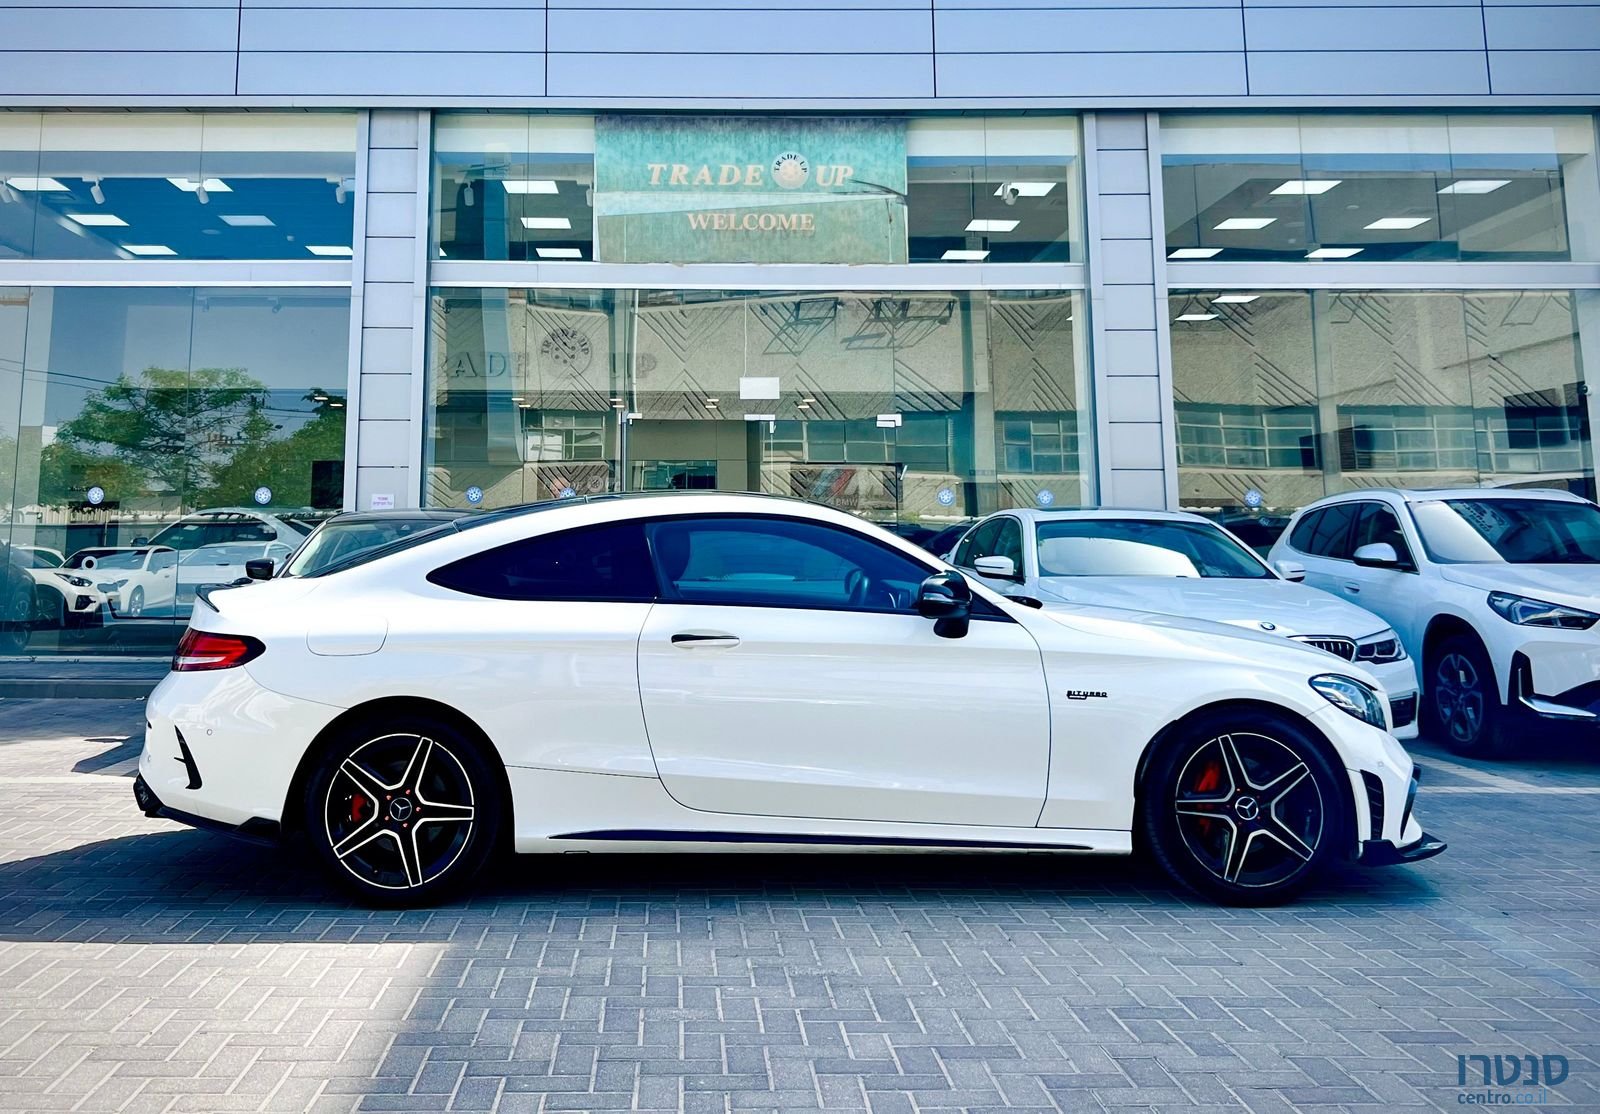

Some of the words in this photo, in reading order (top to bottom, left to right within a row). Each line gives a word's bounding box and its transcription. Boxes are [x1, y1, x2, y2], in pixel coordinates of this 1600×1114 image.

[647, 163, 764, 186] TRADE
[816, 165, 854, 187] UP
[687, 213, 815, 231] WELCOME
